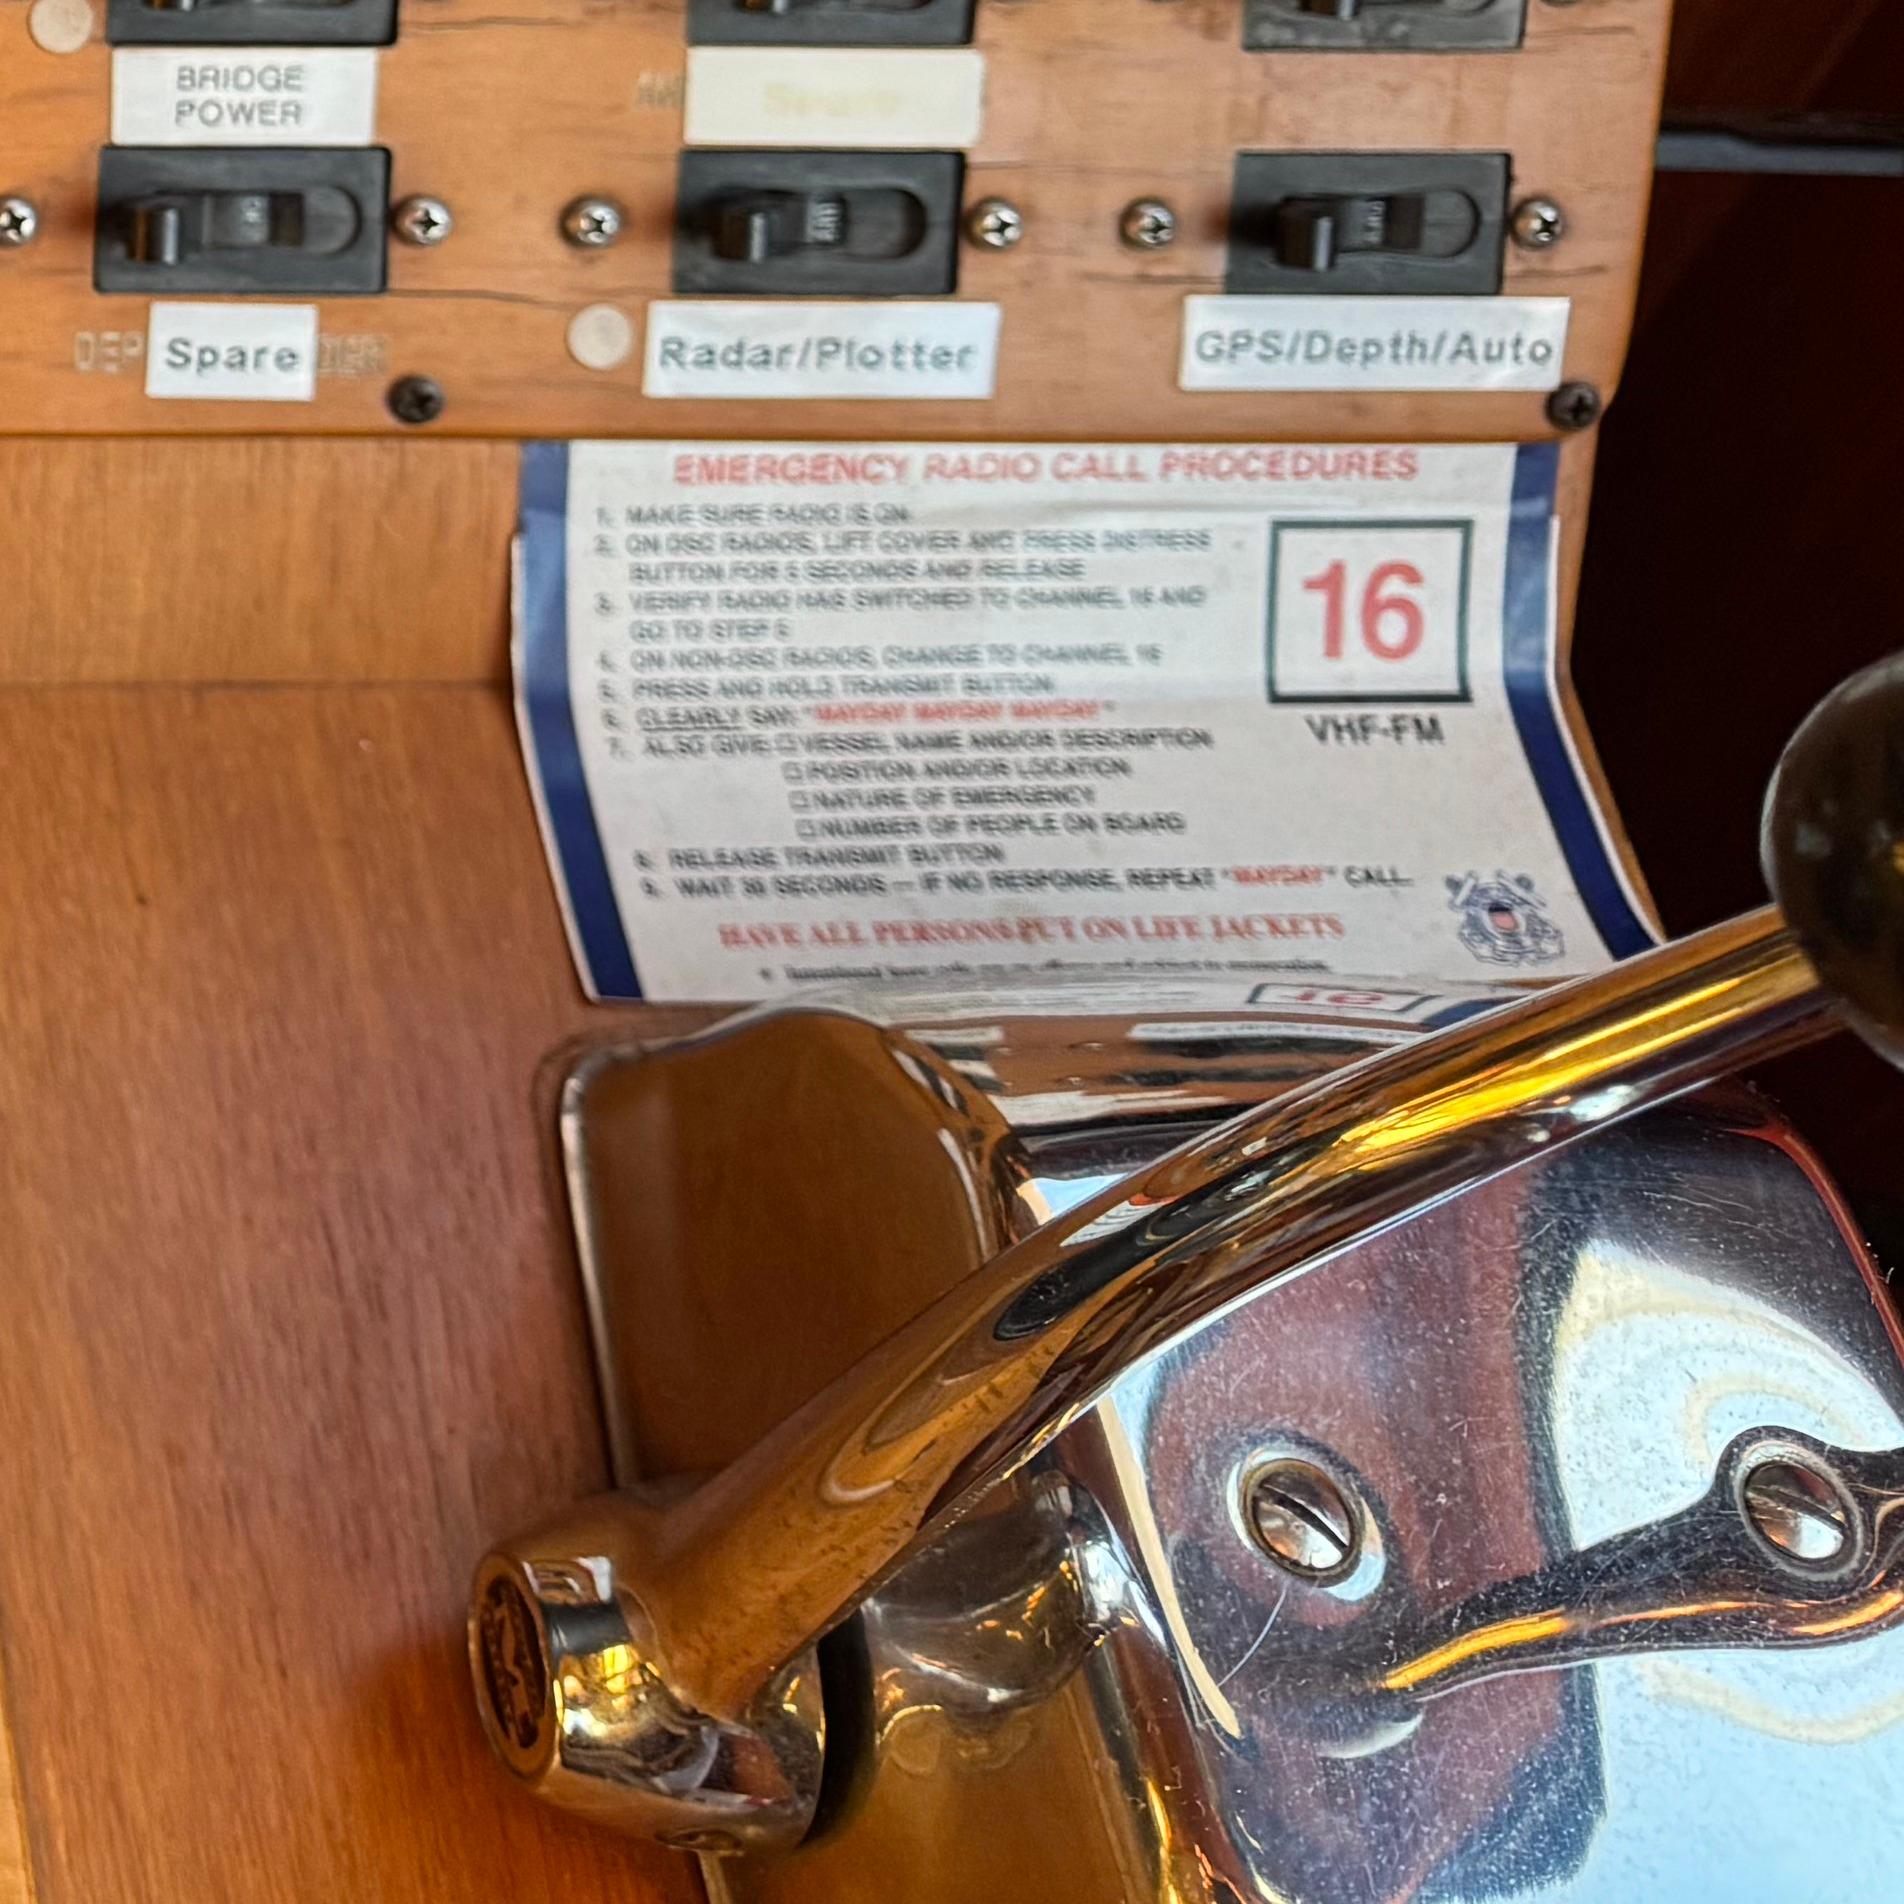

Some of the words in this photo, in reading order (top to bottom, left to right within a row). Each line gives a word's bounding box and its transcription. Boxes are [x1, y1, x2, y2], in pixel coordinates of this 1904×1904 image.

[175, 65, 304, 93] BRIDGE
[175, 99, 302, 127] POWER
[165, 336, 301, 376] Spare
[658, 333, 976, 374] Radar/Plotter
[1194, 331, 1553, 368] GPS/Depth/Auto
[673, 455, 912, 486] EMERGENCY
[923, 456, 1041, 484] RADIO
[1051, 455, 1147, 484] CALL
[1158, 447, 1420, 485] PROCEDURES
[1302, 559, 1425, 661] 16
[1305, 715, 1445, 745] VHF-FM
